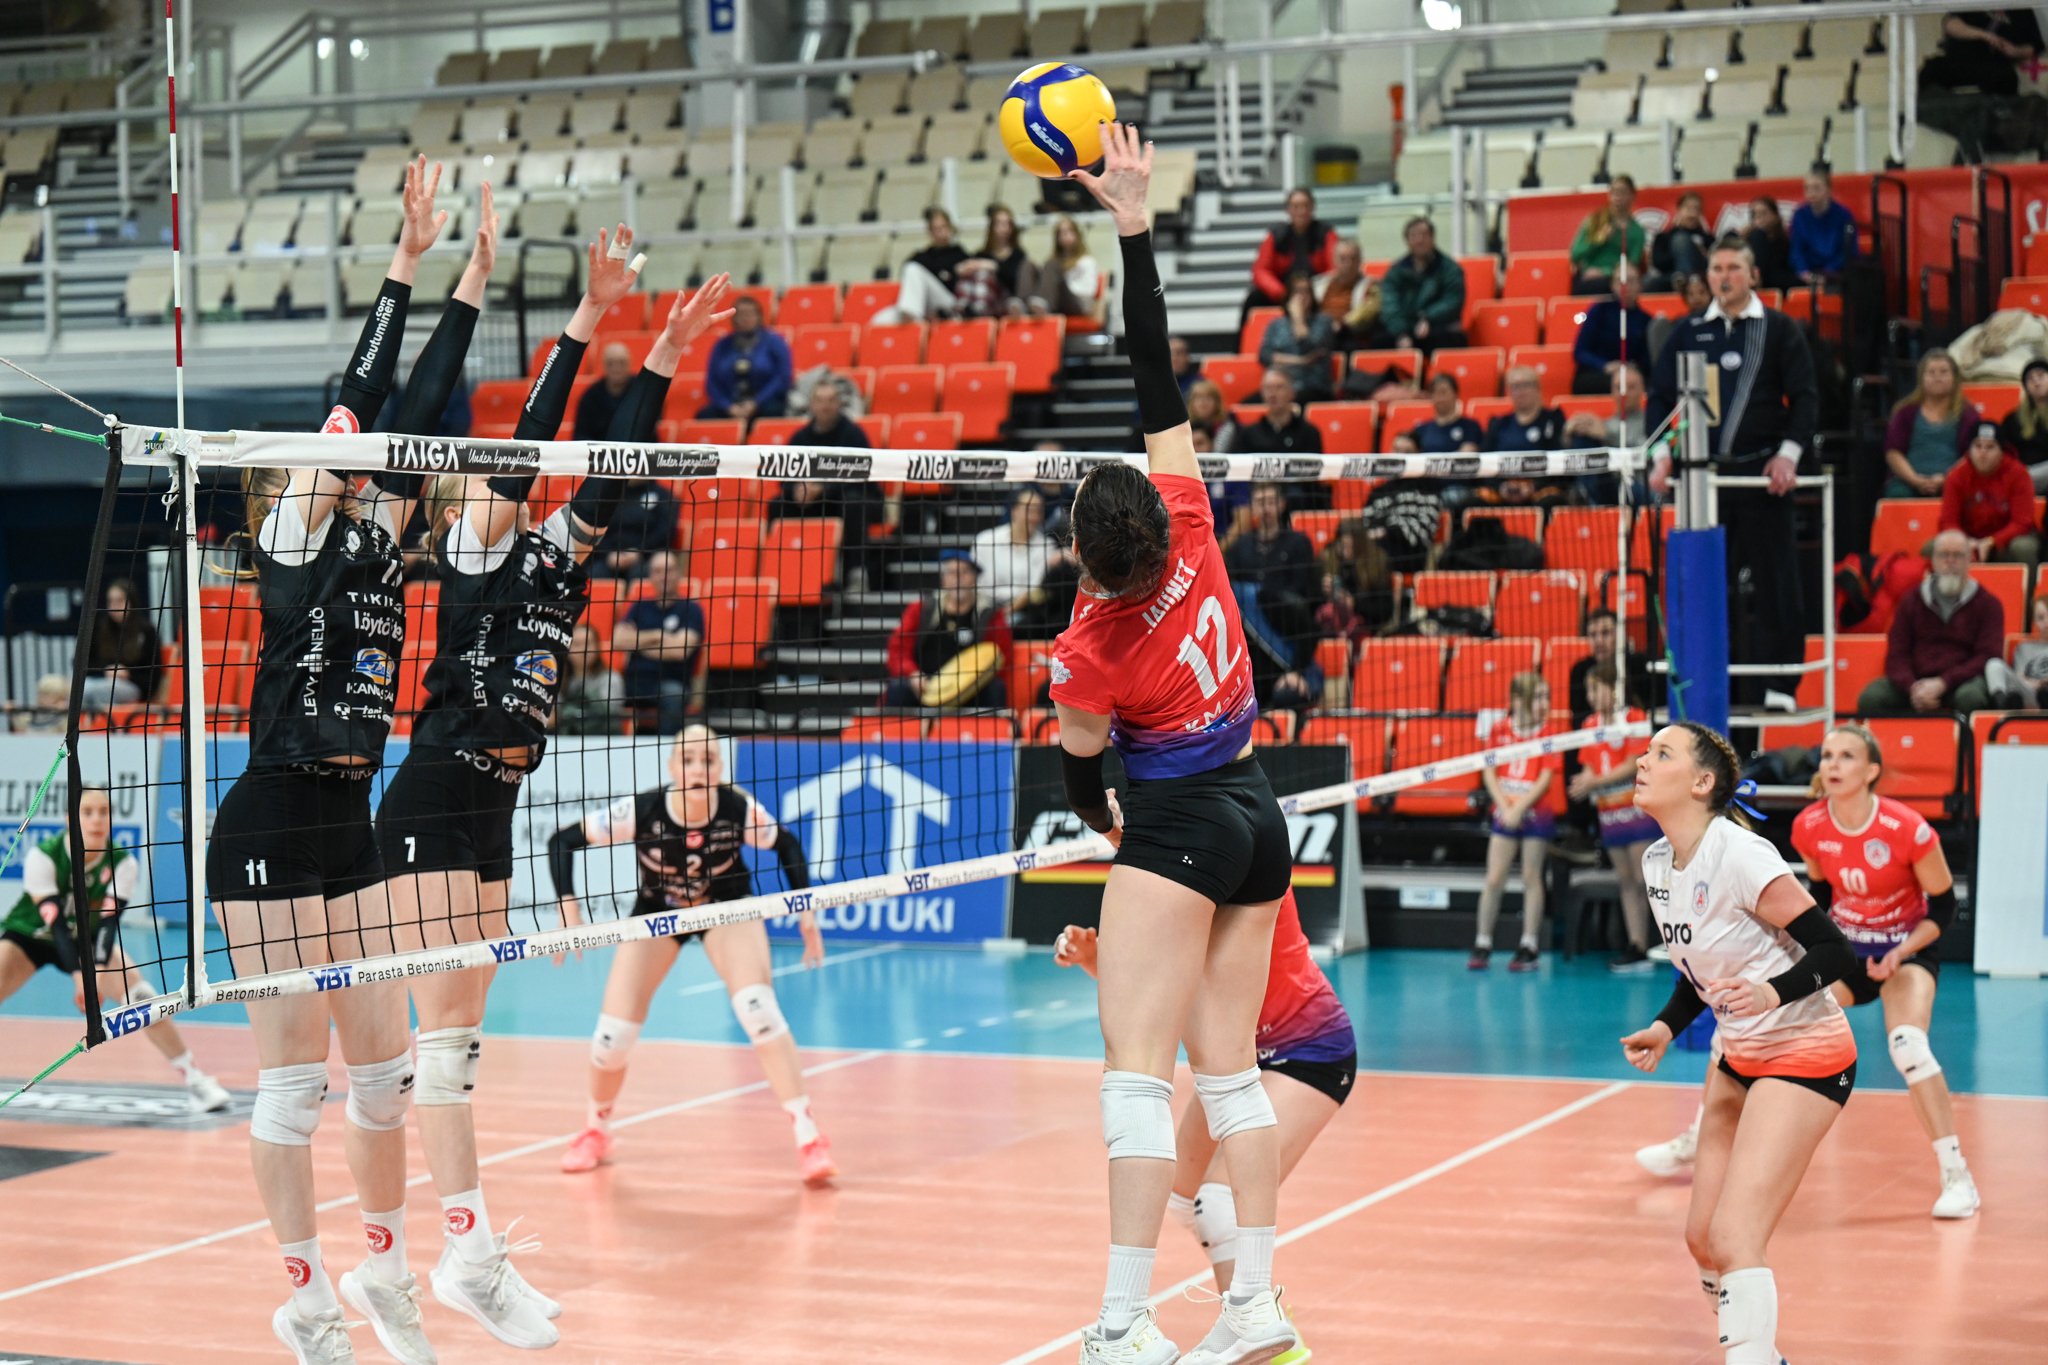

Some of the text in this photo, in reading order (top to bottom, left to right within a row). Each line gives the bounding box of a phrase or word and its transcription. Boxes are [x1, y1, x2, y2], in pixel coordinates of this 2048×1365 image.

[356, 298, 396, 379] Palautuminen
[390, 438, 460, 471] TAIGA
[590, 447, 649, 475] TAIGA
[760, 451, 811, 477] TAIGA
[909, 455, 954, 480] TAIGA
[1038, 456, 1077, 480] TAIGA
[1177, 596, 1243, 700] 12
[303, 607, 325, 716] LEVY NELIÖ
[404, 837, 416, 863] 7
[245, 859, 268, 886] 11
[686, 854, 702, 878] 2
[904, 872, 930, 893] YBT
[1839, 867, 1868, 896] 10
[783, 893, 813, 914] YBT
[644, 914, 679, 938] YBT
[681, 916, 717, 931] Parasta
[488, 938, 528, 964] YBT
[530, 940, 571, 957] Parasta
[307, 957, 466, 993] YBT Parasta Betonista.
[105, 1004, 152, 1039] YBT
[215, 984, 282, 1002] Betonista.
